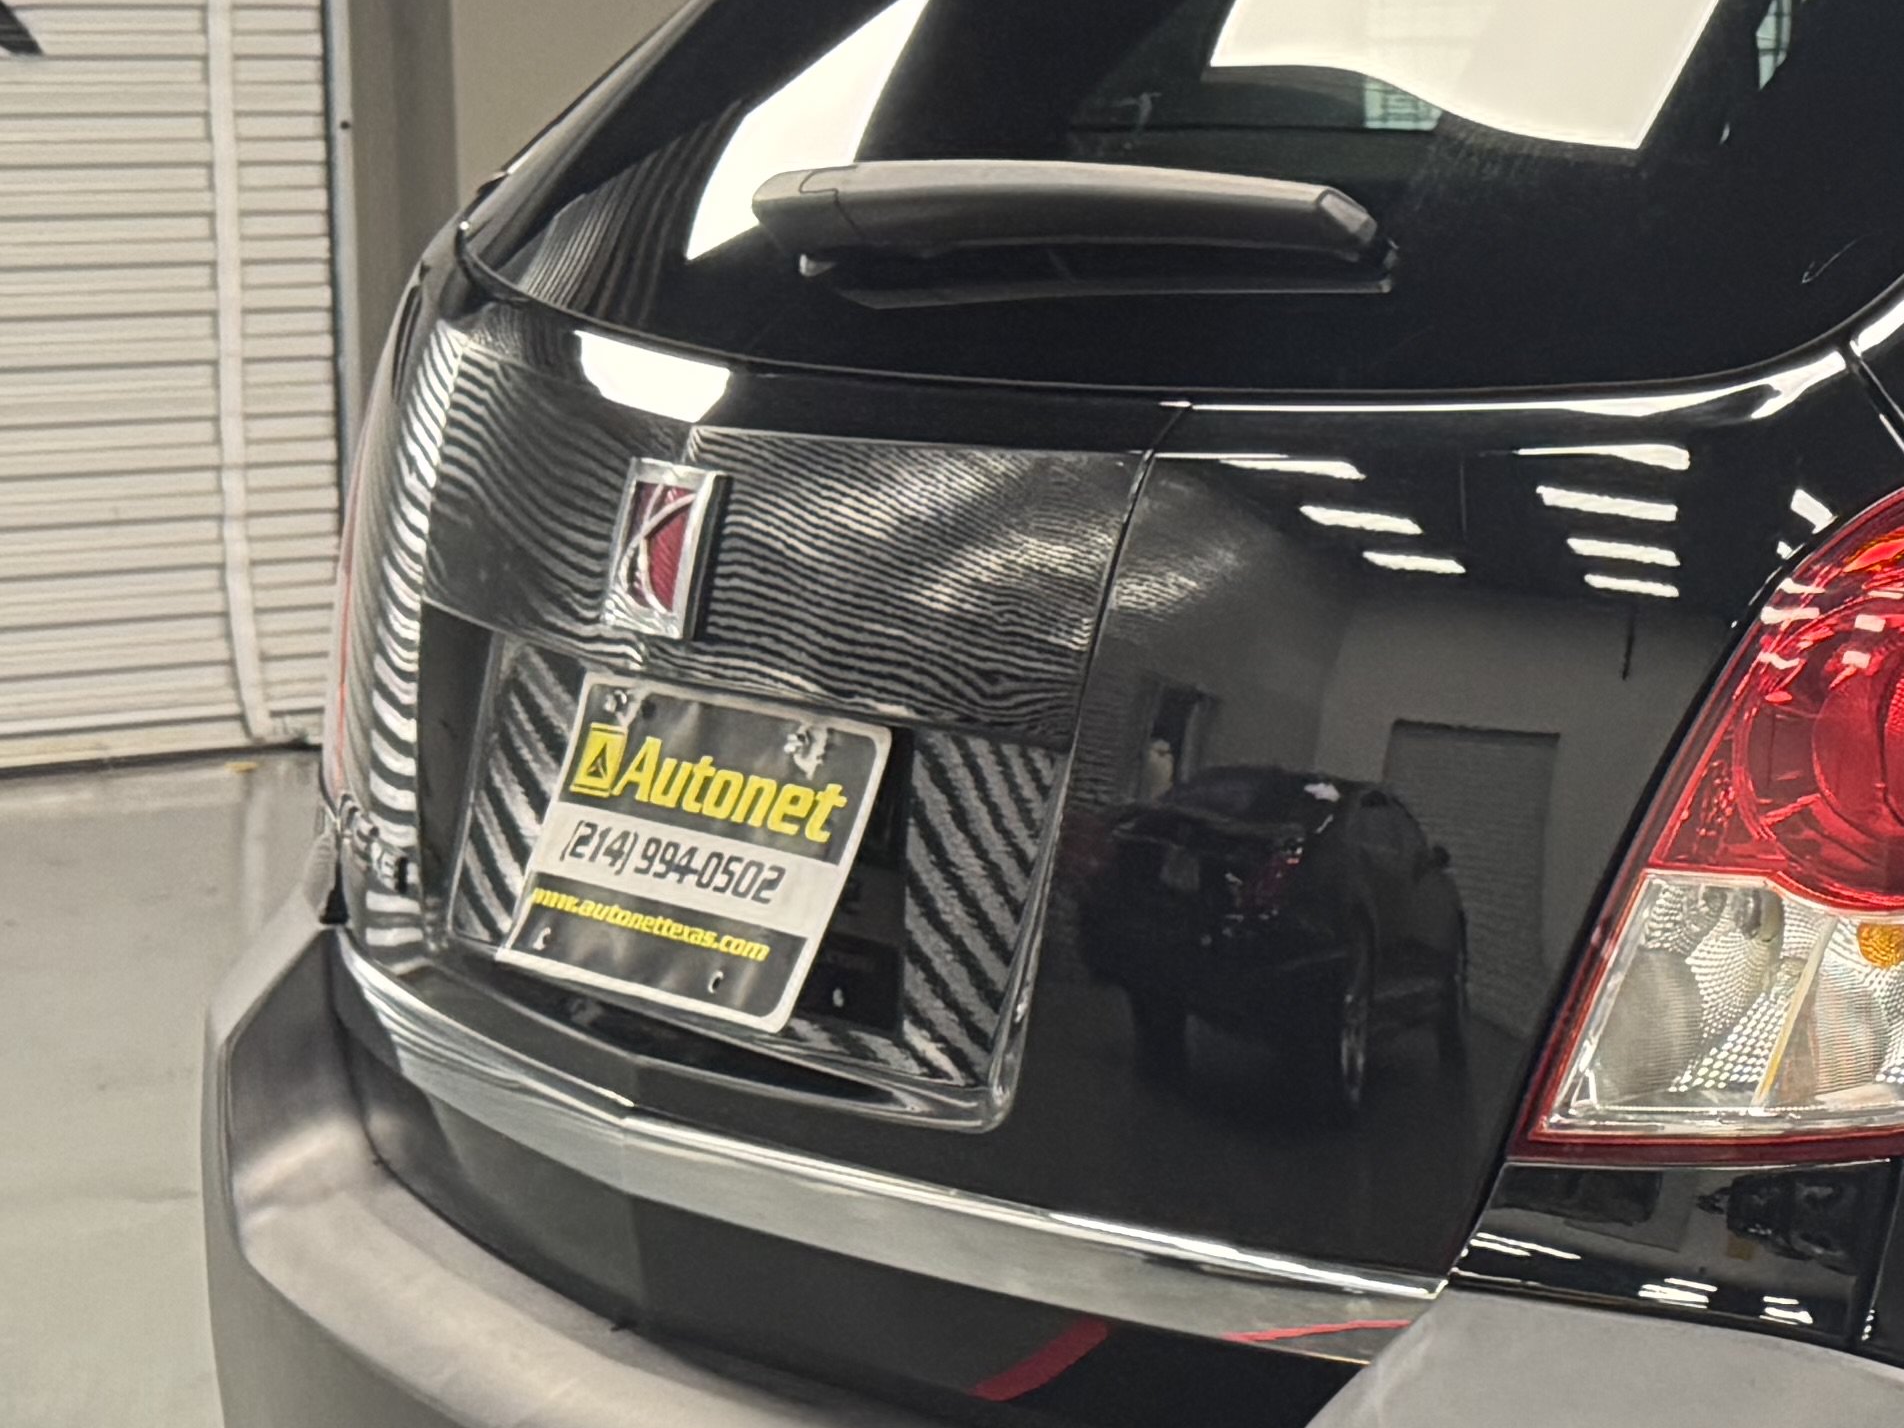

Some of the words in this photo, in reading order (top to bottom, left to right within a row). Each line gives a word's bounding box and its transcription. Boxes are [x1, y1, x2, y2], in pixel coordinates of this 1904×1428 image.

[610, 735, 848, 844] Autonet
[560, 819, 639, 876] (214)
[634, 837, 787, 905] 994-0502
[530, 887, 770, 962] www.autonettexas.com
